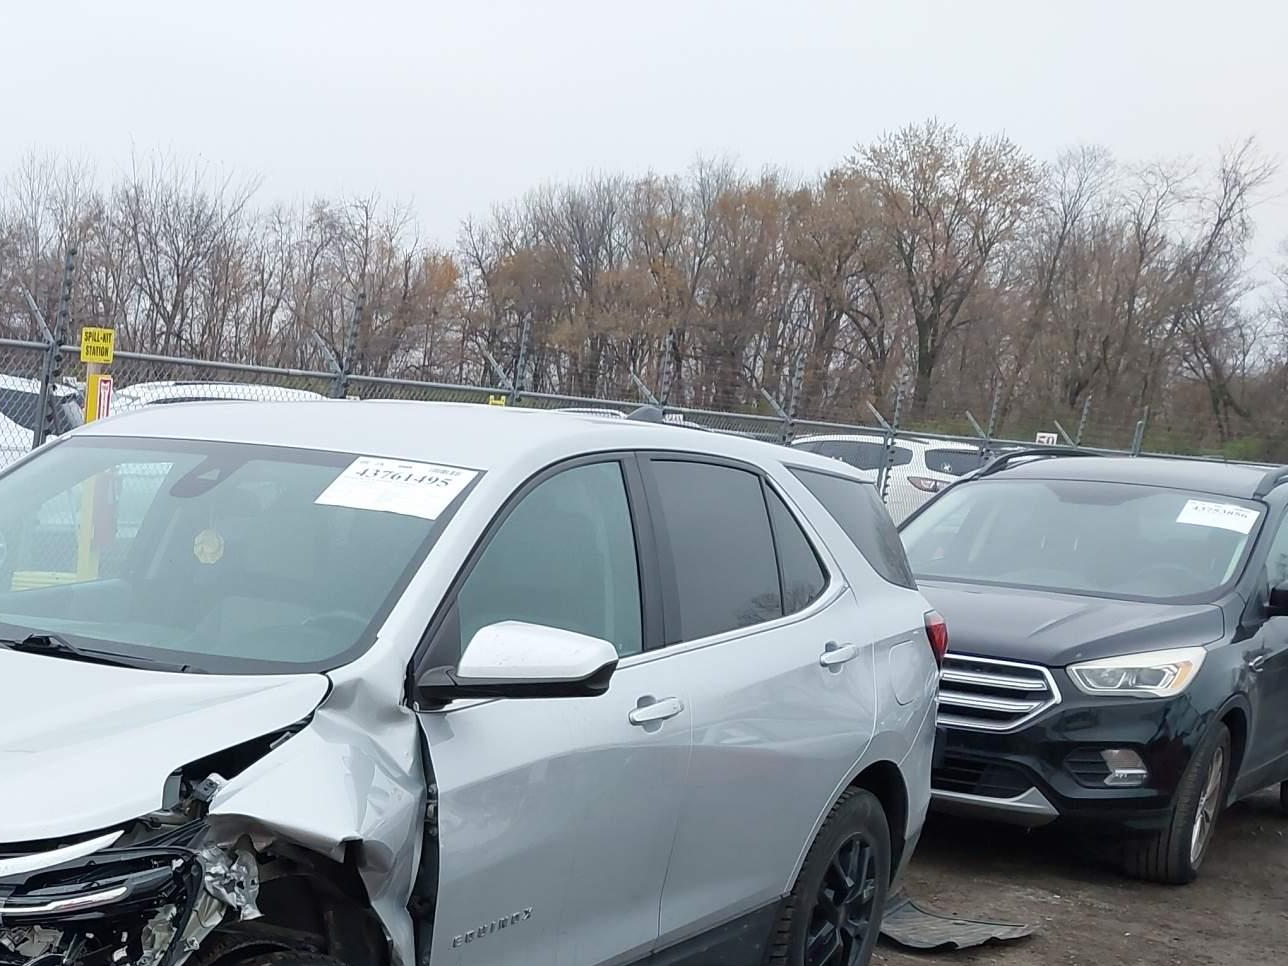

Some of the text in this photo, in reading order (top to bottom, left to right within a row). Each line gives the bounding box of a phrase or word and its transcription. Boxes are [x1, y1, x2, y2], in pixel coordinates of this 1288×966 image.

[84, 331, 112, 344] SPILL-KIT
[85, 345, 109, 357] STATION
[356, 468, 452, 487] 43761495
